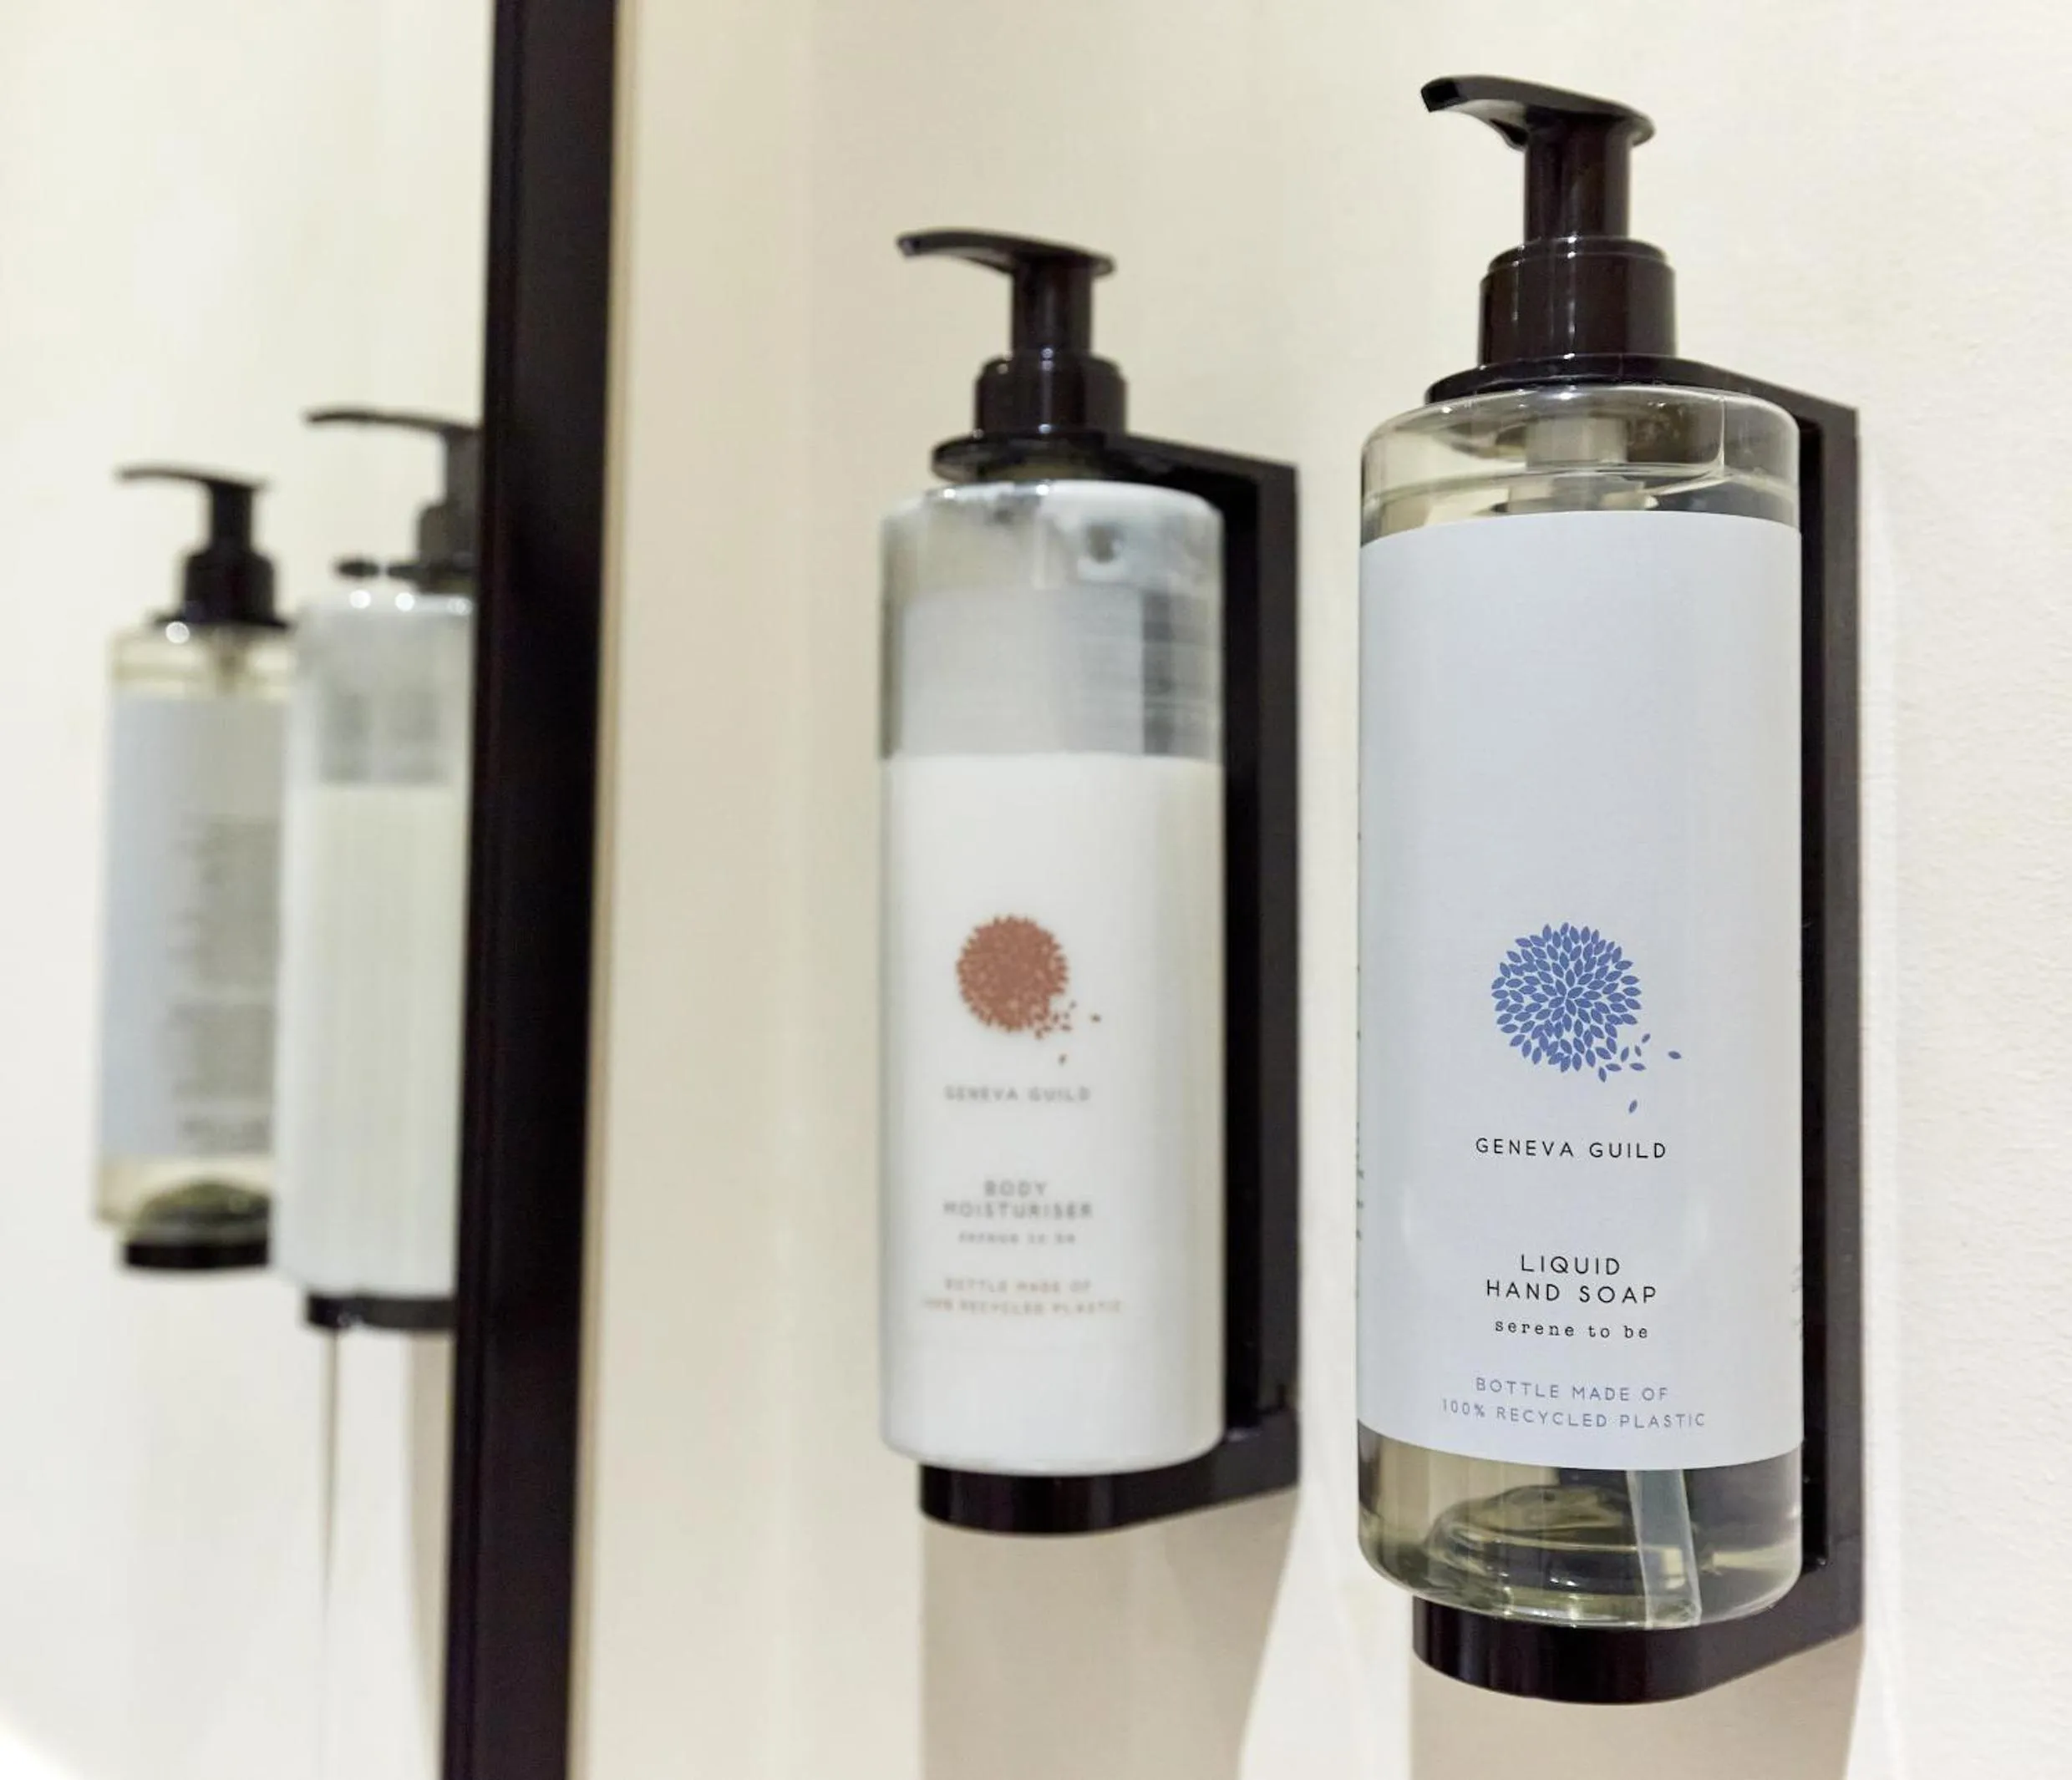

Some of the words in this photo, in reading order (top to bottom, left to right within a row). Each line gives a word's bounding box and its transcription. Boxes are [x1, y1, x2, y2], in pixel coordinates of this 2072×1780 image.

[944, 1086, 1018, 1103] GENEVA
[1027, 1087, 1092, 1103] GUILD
[1475, 1138, 1575, 1158] GENEVA
[1588, 1141, 1667, 1159] GUILD
[983, 1179, 1048, 1198] BODY
[942, 1200, 1093, 1220] MOISTURISER
[1520, 1254, 1621, 1275] LIQUID
[1486, 1280, 1561, 1302] HAND
[1578, 1286, 1657, 1305] SOAP
[1495, 1321, 1575, 1337] serene
[1588, 1325, 1611, 1339] to
[1623, 1325, 1648, 1339] be
[1475, 1377, 1559, 1399] BOTTLE
[1572, 1386, 1630, 1402] MADE
[1641, 1387, 1668, 1402] OF
[1442, 1398, 1485, 1417] 100%
[1496, 1406, 1607, 1428] RECYCLED
[1619, 1412, 1705, 1429] PLASTIC
